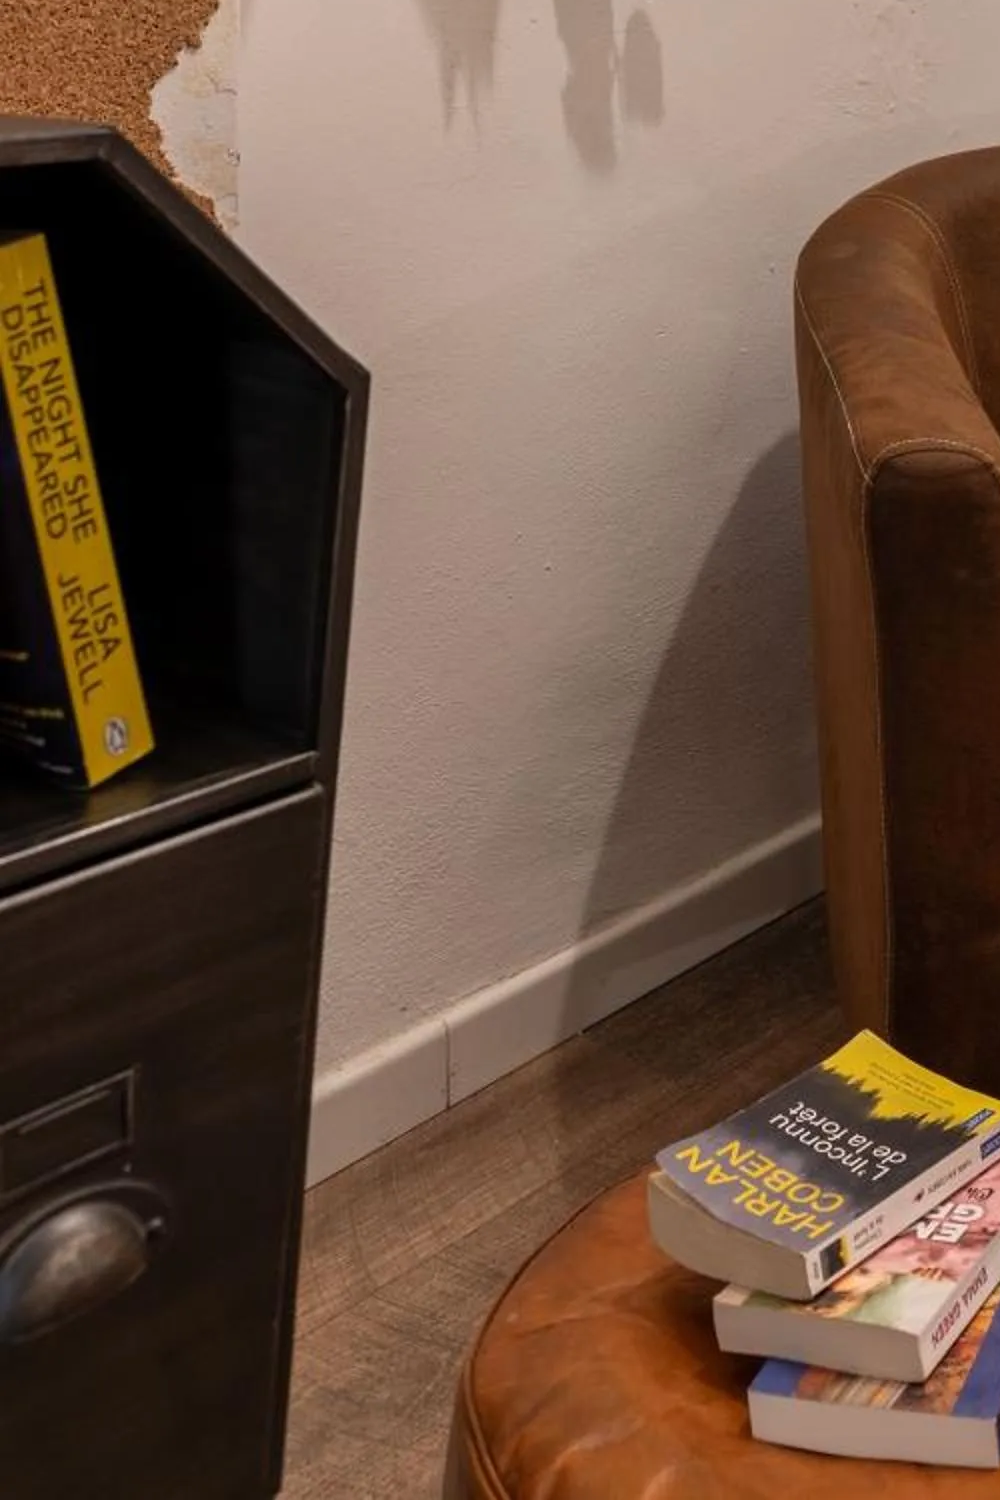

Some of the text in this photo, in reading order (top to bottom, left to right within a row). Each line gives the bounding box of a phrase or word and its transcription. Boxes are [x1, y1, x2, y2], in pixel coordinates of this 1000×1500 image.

[2, 304, 68, 540] DISAPPEARED
[23, 276, 98, 544] THE NIGHT SHE
[57, 572, 104, 704] JEWELL
[88, 583, 122, 661] LISA
[716, 1139, 845, 1213] COBEN
[789, 1101, 907, 1164] de la forêt
[675, 1144, 834, 1239] HARLAN
